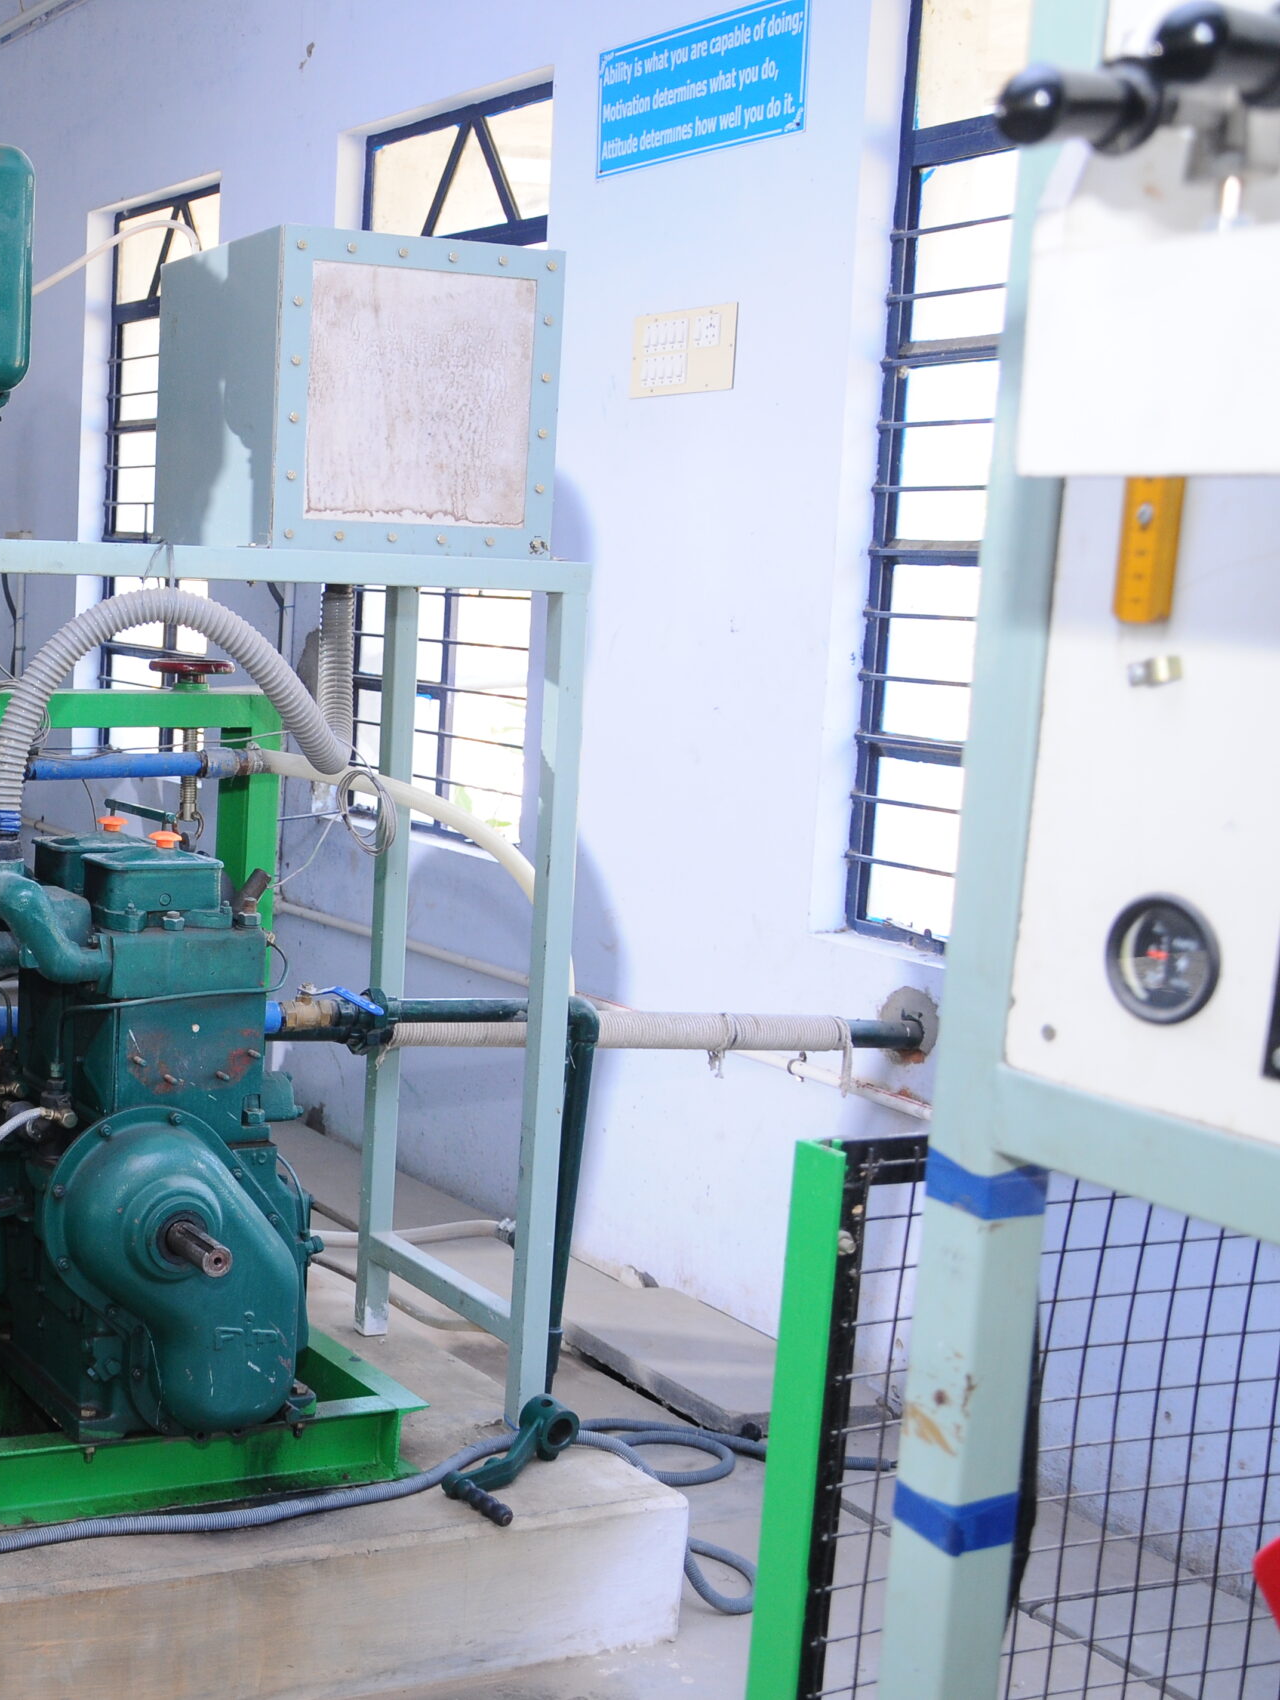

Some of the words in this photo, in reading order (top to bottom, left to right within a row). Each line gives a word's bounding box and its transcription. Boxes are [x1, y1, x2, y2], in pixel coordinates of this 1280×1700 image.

[603, 60, 632, 86] Ability
[634, 57, 643, 77] is
[644, 48, 669, 74] what
[670, 46, 689, 71] you
[690, 40, 708, 60] are
[710, 24, 751, 56] capable
[753, 16, 767, 41] of
[602, 94, 651, 123] Motivation
[652, 80, 707, 109] determines
[709, 67, 737, 94] what
[738, 65, 759, 91] you
[761, 56, 779, 82] do,
[602, 133, 638, 160] Attitude
[640, 122, 693, 151] determines
[694, 115, 717, 137] how
[719, 104, 742, 131] well
[743, 104, 764, 129] you
[766, 96, 781, 119] do
[783, 92, 796, 115] it.
